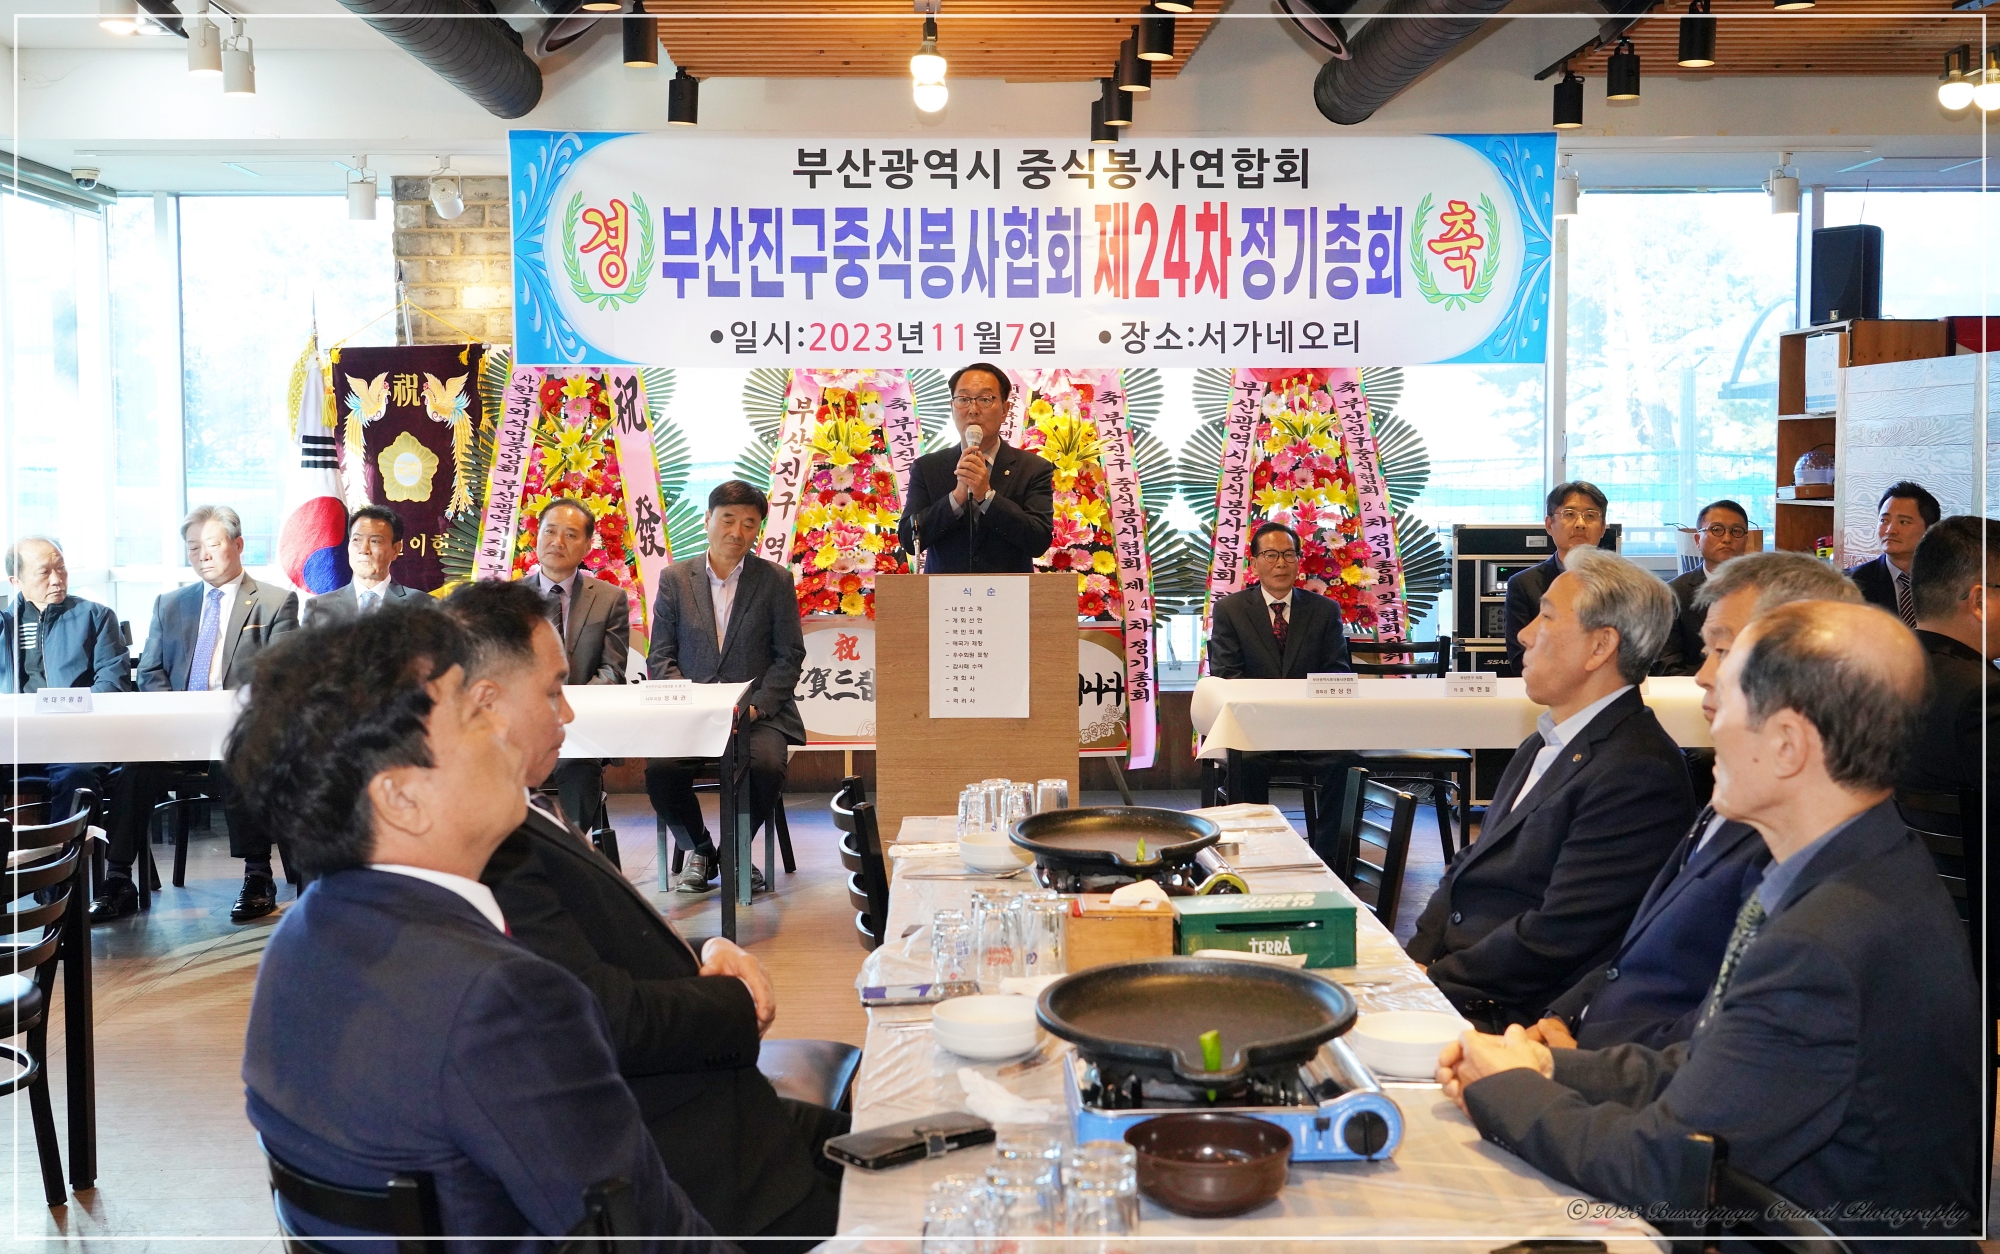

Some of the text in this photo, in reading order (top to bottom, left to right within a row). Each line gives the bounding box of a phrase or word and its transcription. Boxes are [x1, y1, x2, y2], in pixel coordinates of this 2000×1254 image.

[793, 148, 1310, 190] 부산광역시 중식봉사연합회
[580, 198, 629, 288] 경
[662, 201, 1402, 300] 부산진구중식봉사협회 제24차 정기총회
[1427, 199, 1483, 290] 축
[392, 373, 421, 407] 祝
[886, 397, 912, 412] 축
[1096, 390, 1121, 406] 축
[1336, 382, 1359, 394] 축
[772, 396, 815, 521] 부산진구
[1099, 411, 1132, 472] 부산진구
[832, 632, 861, 662] 祝
[1248, 936, 1293, 955] TERRA
